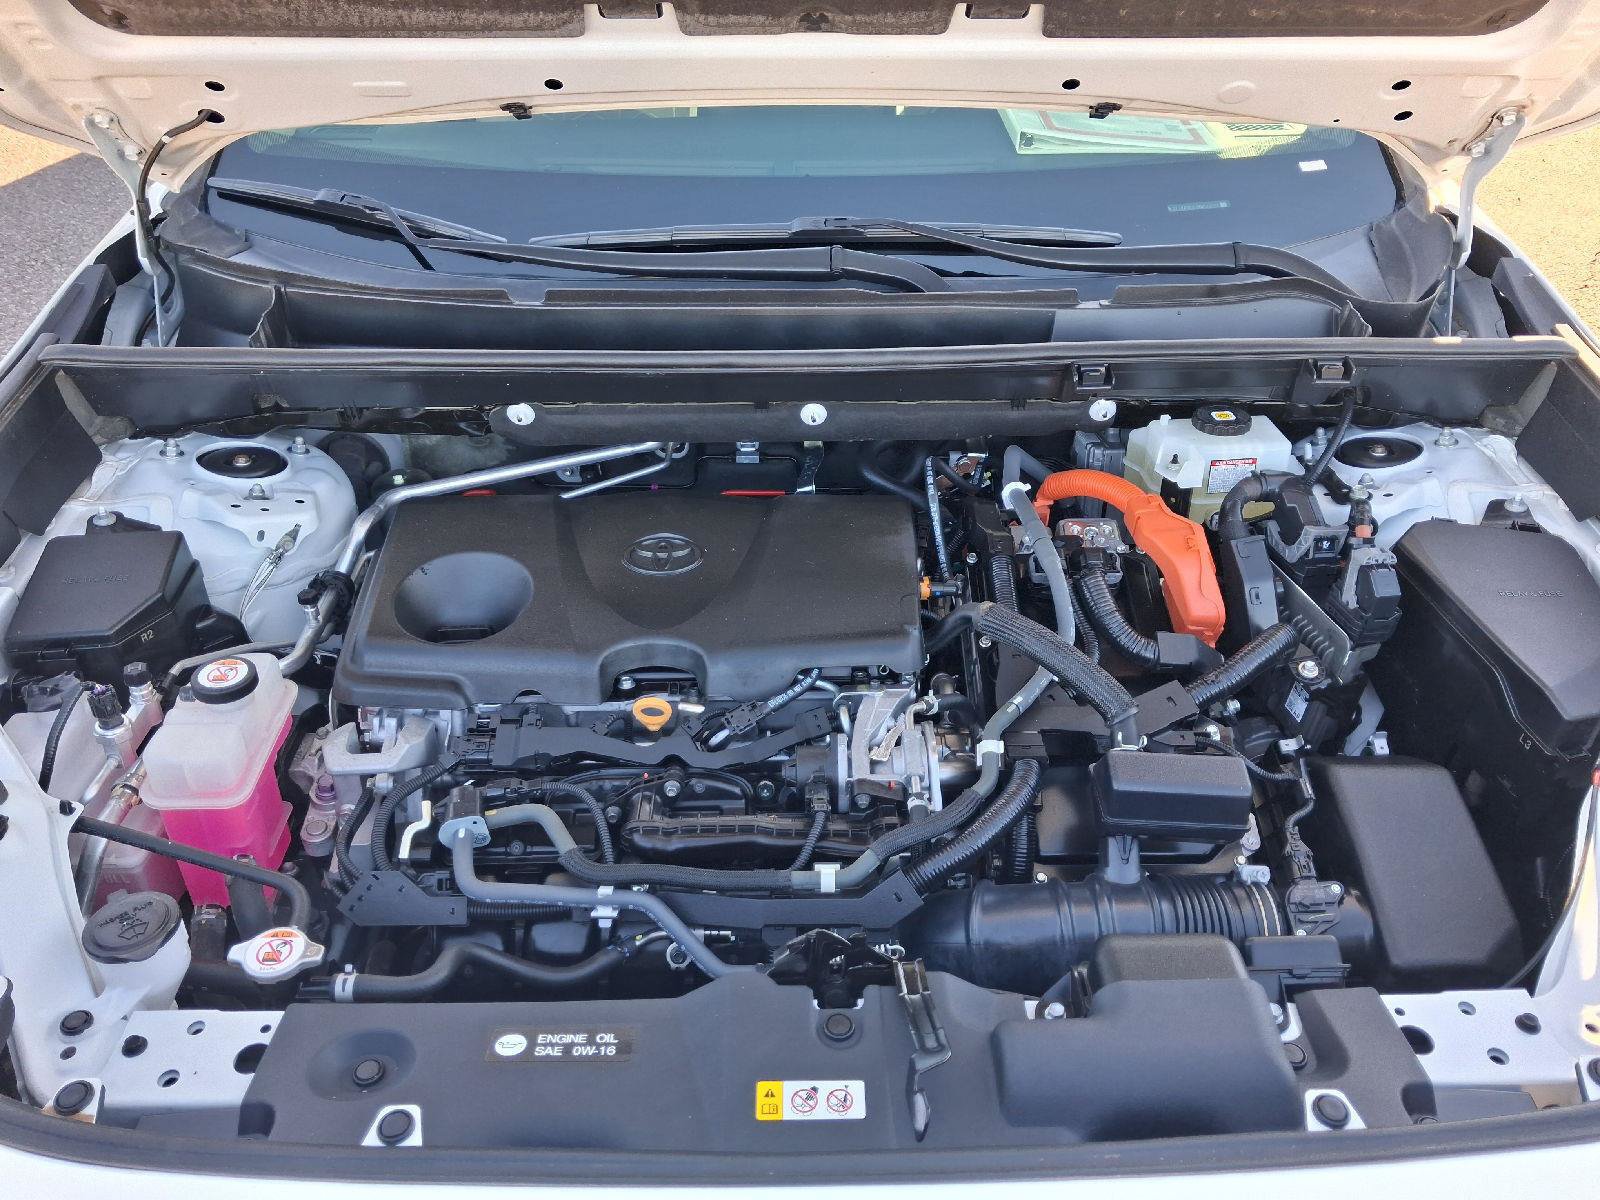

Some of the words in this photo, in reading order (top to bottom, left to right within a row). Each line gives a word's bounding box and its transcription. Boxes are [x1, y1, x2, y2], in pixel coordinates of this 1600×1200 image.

[141, 629, 154, 642] R2
[537, 1033, 588, 1044] ENGINE
[596, 1032, 619, 1043] OIL
[534, 1046, 564, 1056] SAE
[572, 1045, 616, 1056] 0W-16
